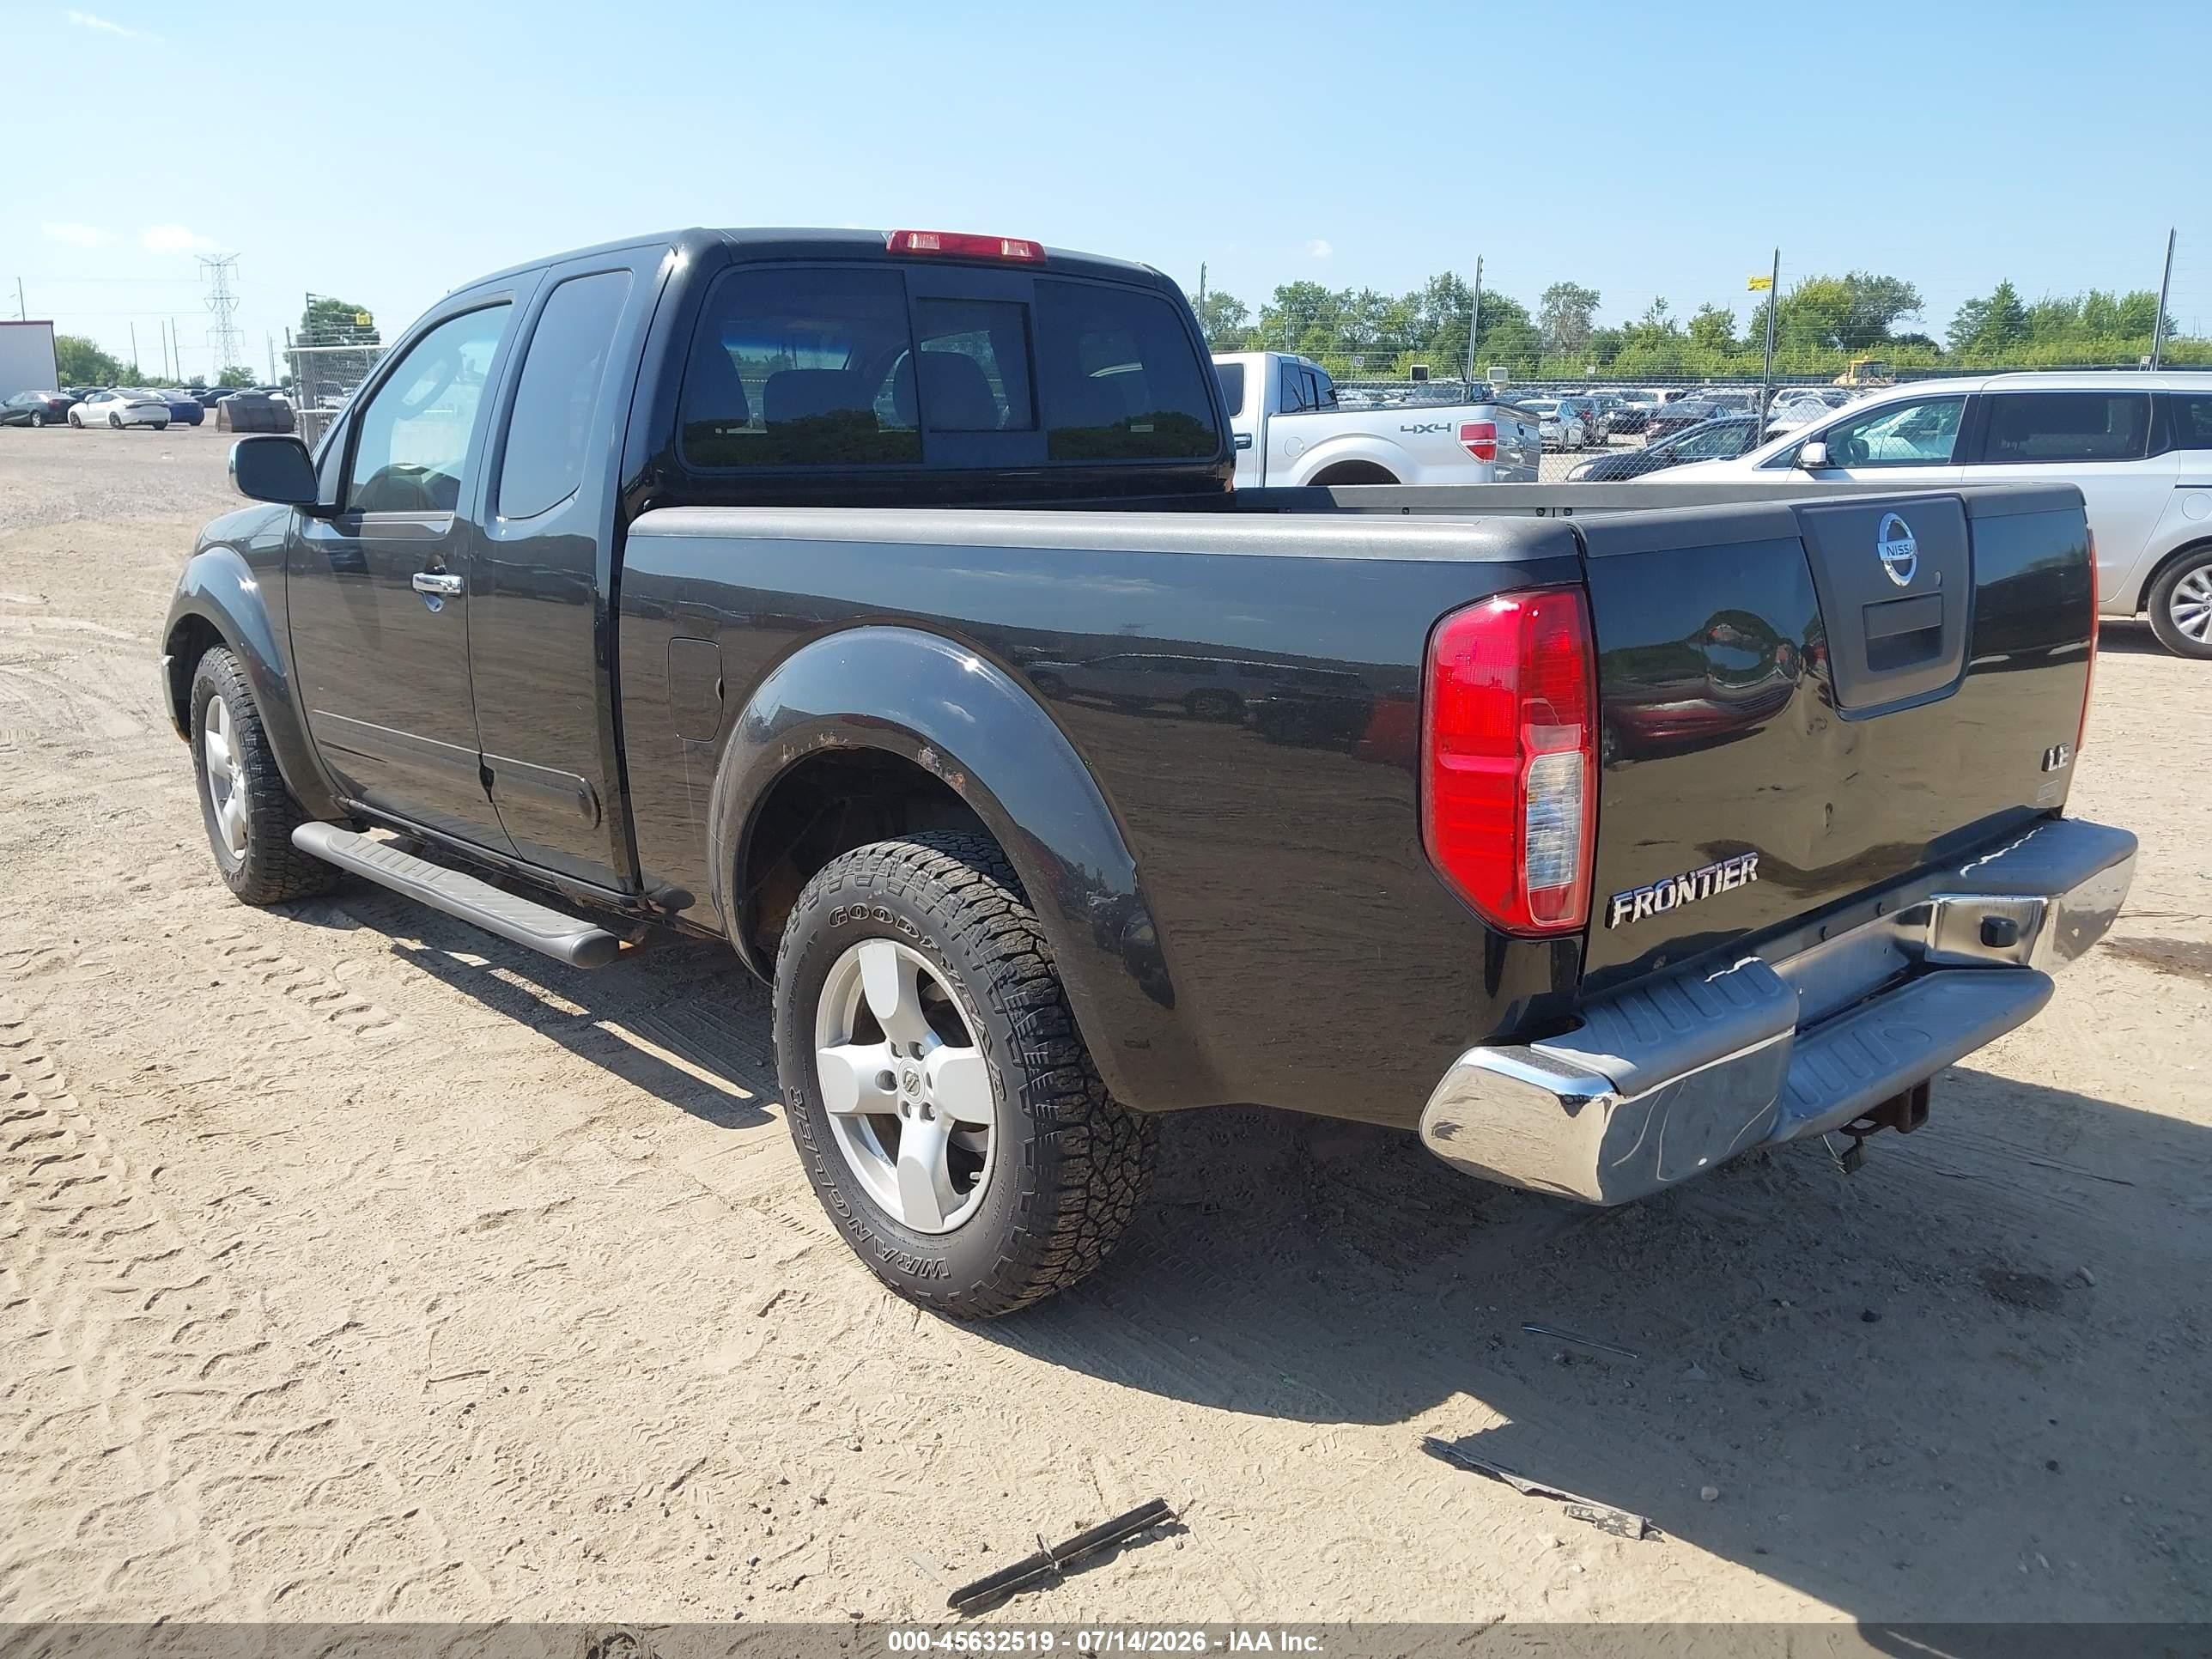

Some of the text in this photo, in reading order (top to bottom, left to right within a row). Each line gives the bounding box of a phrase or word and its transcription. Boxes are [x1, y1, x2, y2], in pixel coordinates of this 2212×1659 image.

[2041, 743, 2070, 772] LE
[1604, 851, 1759, 929] FRONTIER
[828, 902, 1008, 1102] GOODYEAR
[788, 1085, 951, 1280] WRANGLER
